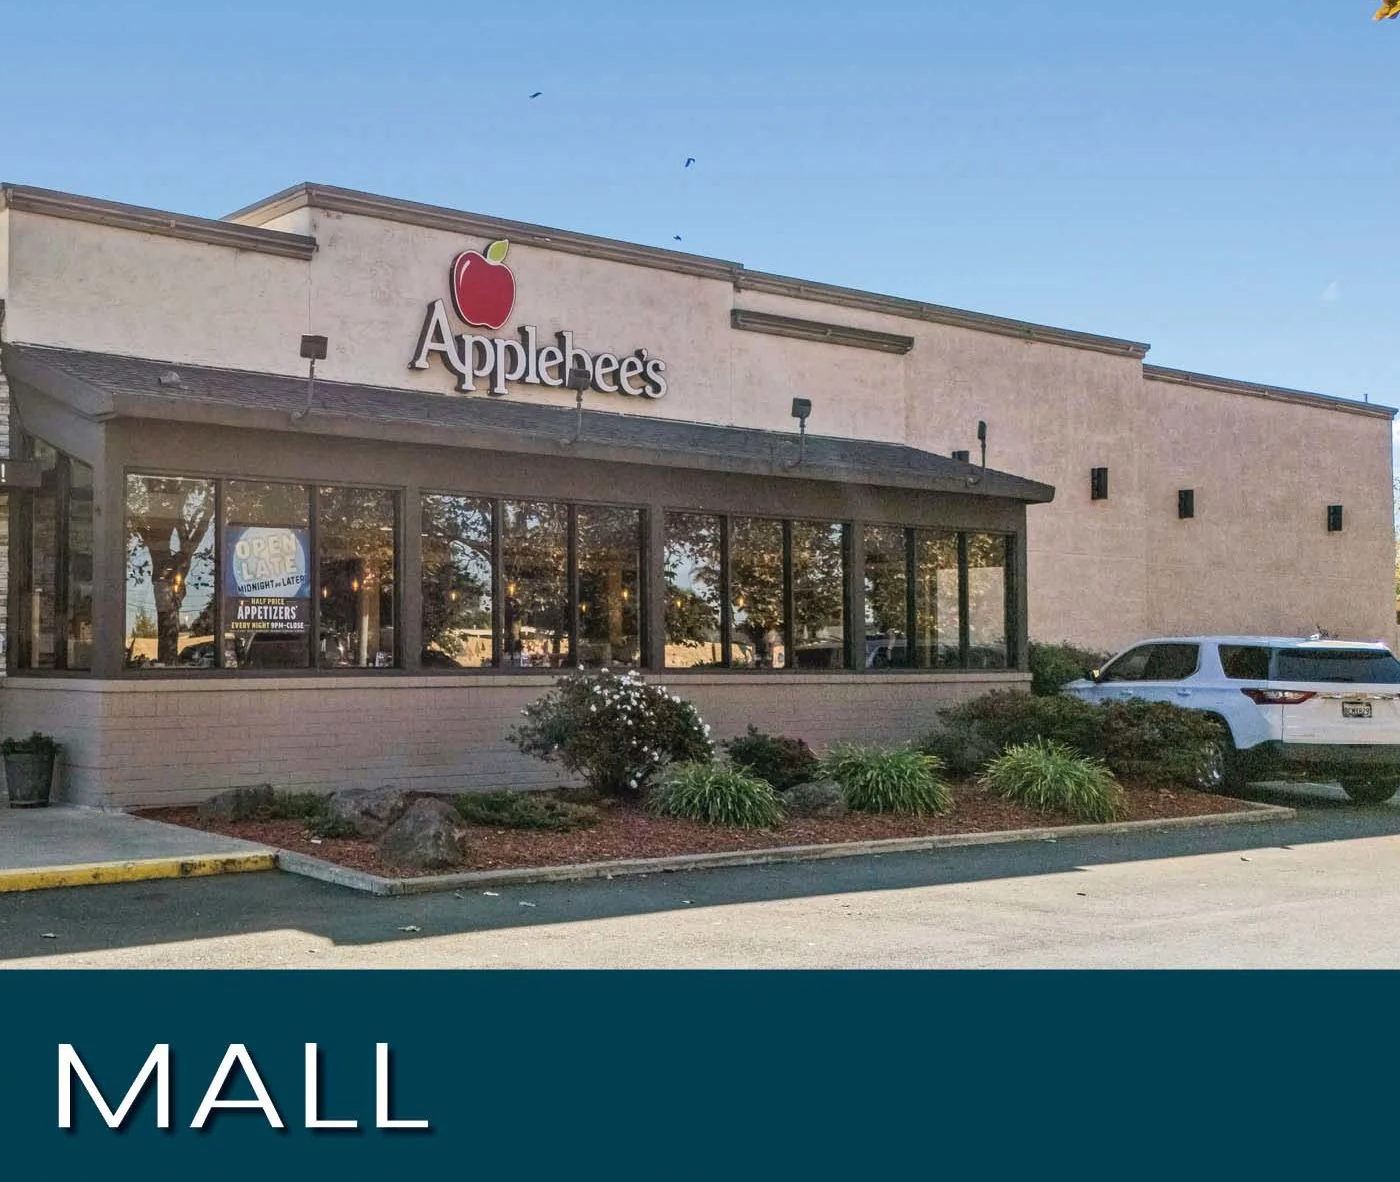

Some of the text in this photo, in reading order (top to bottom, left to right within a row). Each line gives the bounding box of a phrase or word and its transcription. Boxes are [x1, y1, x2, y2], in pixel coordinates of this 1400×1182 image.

[409, 298, 667, 399] Applebee's
[235, 533, 298, 560] OPEN
[241, 558, 297, 580] LATE
[238, 580, 274, 592] MIDNIGHT
[282, 575, 305, 586] LATER
[231, 622, 250, 630] EVERY
[251, 622, 270, 630] NIGHT
